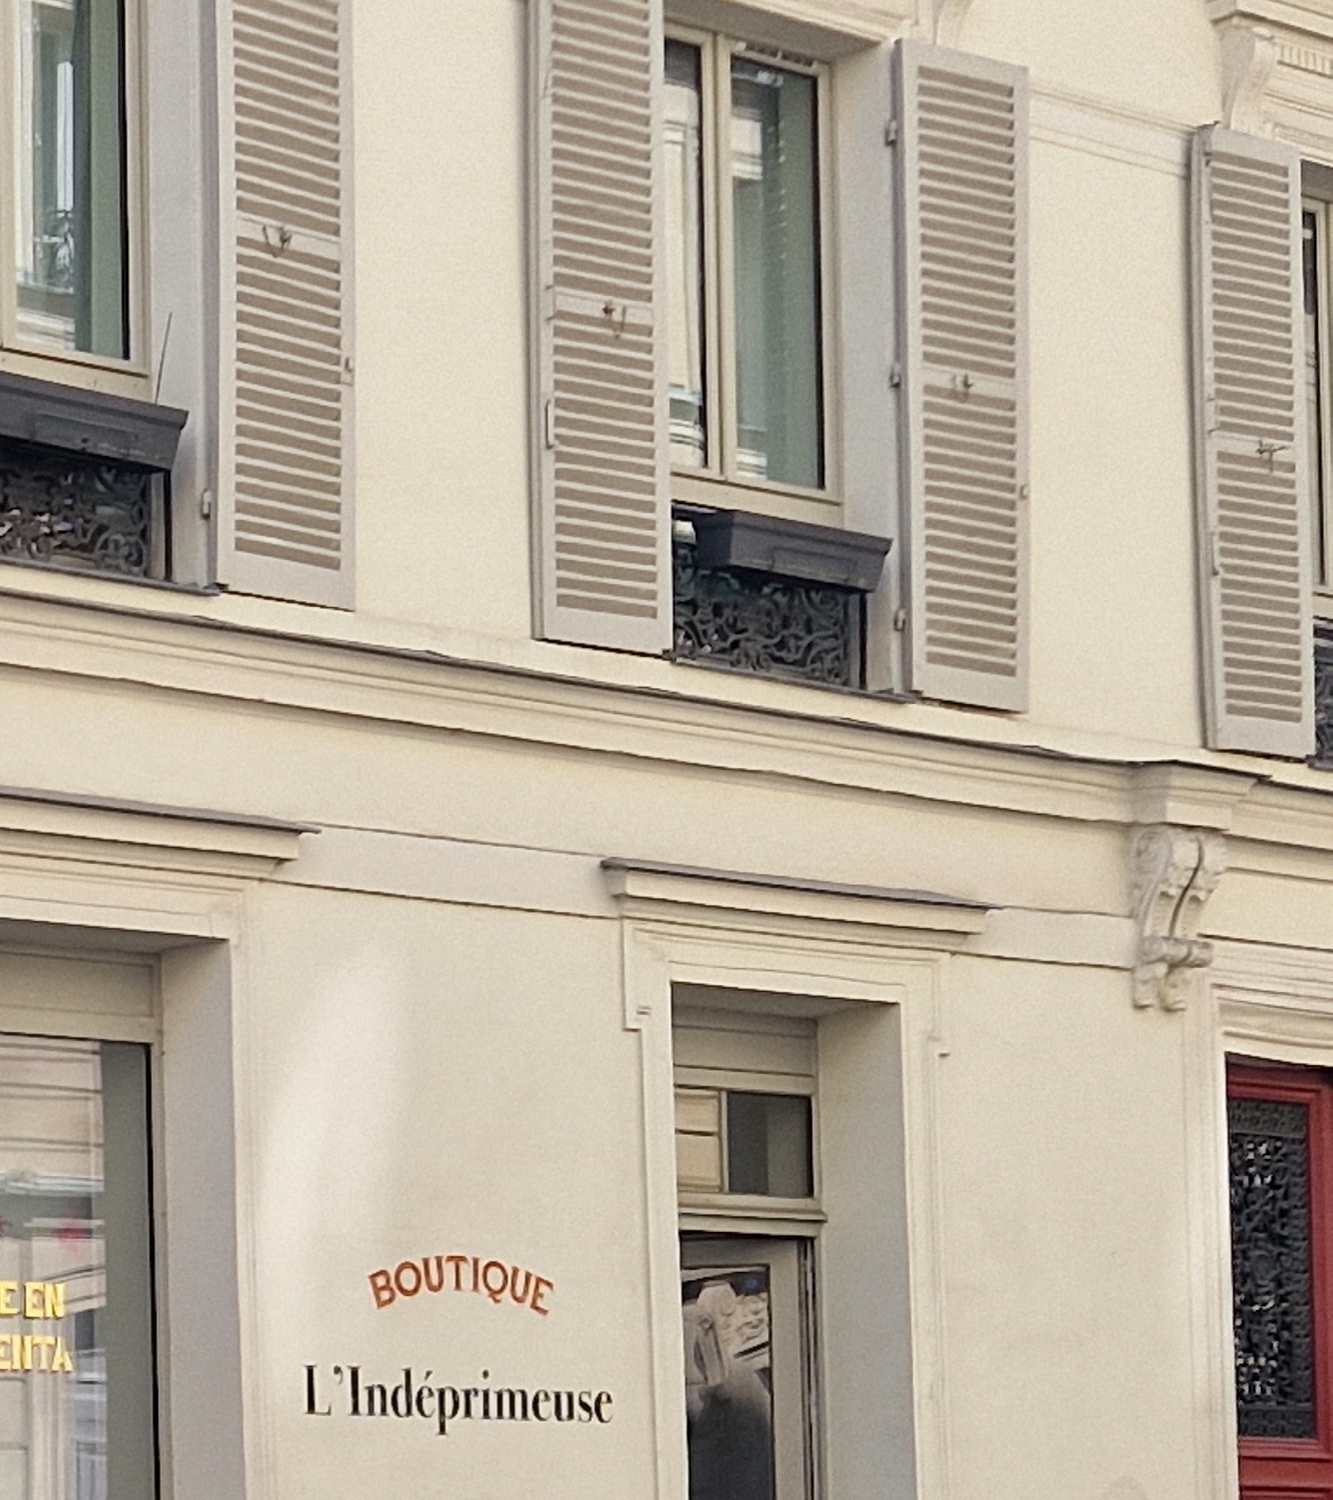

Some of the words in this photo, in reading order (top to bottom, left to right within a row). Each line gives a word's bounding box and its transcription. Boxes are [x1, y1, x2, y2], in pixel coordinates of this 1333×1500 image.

[22, 1281, 67, 1319] EN
[368, 1254, 554, 1316] BOUTIQUE
[304, 1364, 613, 1436] L'Indéprimeuse
